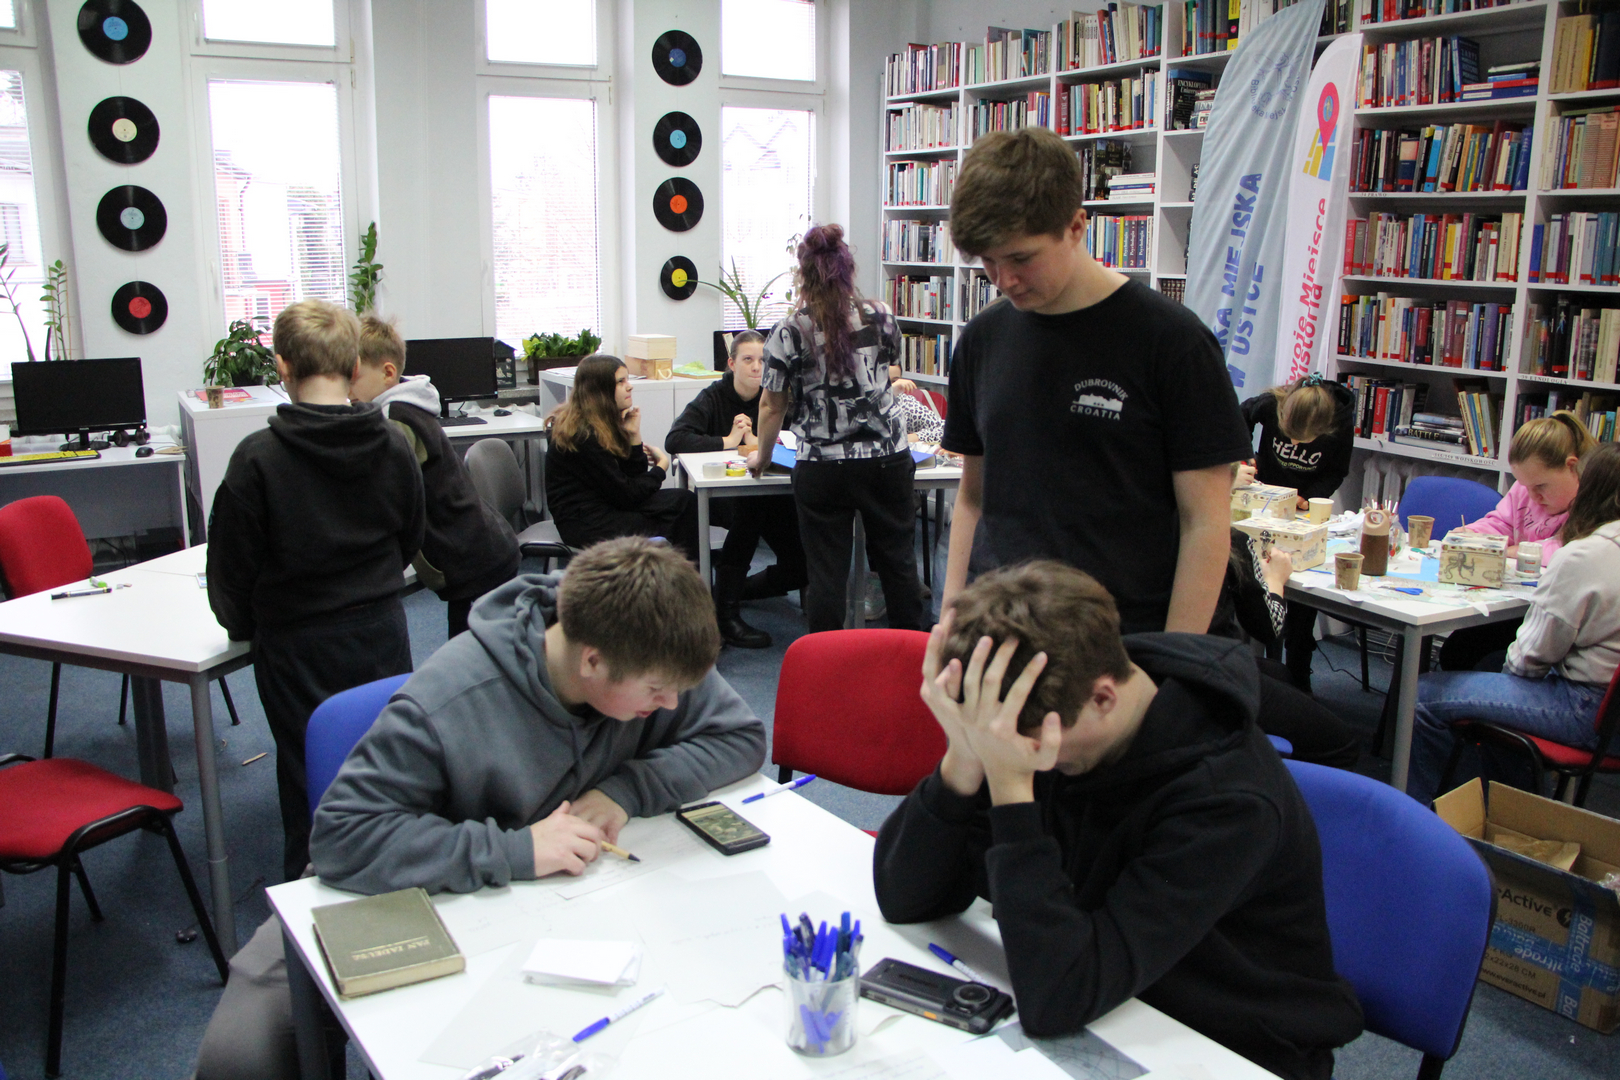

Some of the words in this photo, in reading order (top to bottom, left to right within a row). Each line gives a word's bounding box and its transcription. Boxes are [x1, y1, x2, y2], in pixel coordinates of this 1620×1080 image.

[1221, 173, 1262, 297] MIEJSKA
[1300, 198, 1326, 306] Miejsce
[1297, 283, 1323, 380] istoria
[1227, 363, 1246, 388] W
[1529, 375, 1567, 385] ETNOLOGIA
[1074, 378, 1128, 401] DUBROVNIK
[1070, 404, 1121, 420] CROATIA
[1407, 427, 1440, 440] BATTLE
[1272, 437, 1322, 465] HELLO
